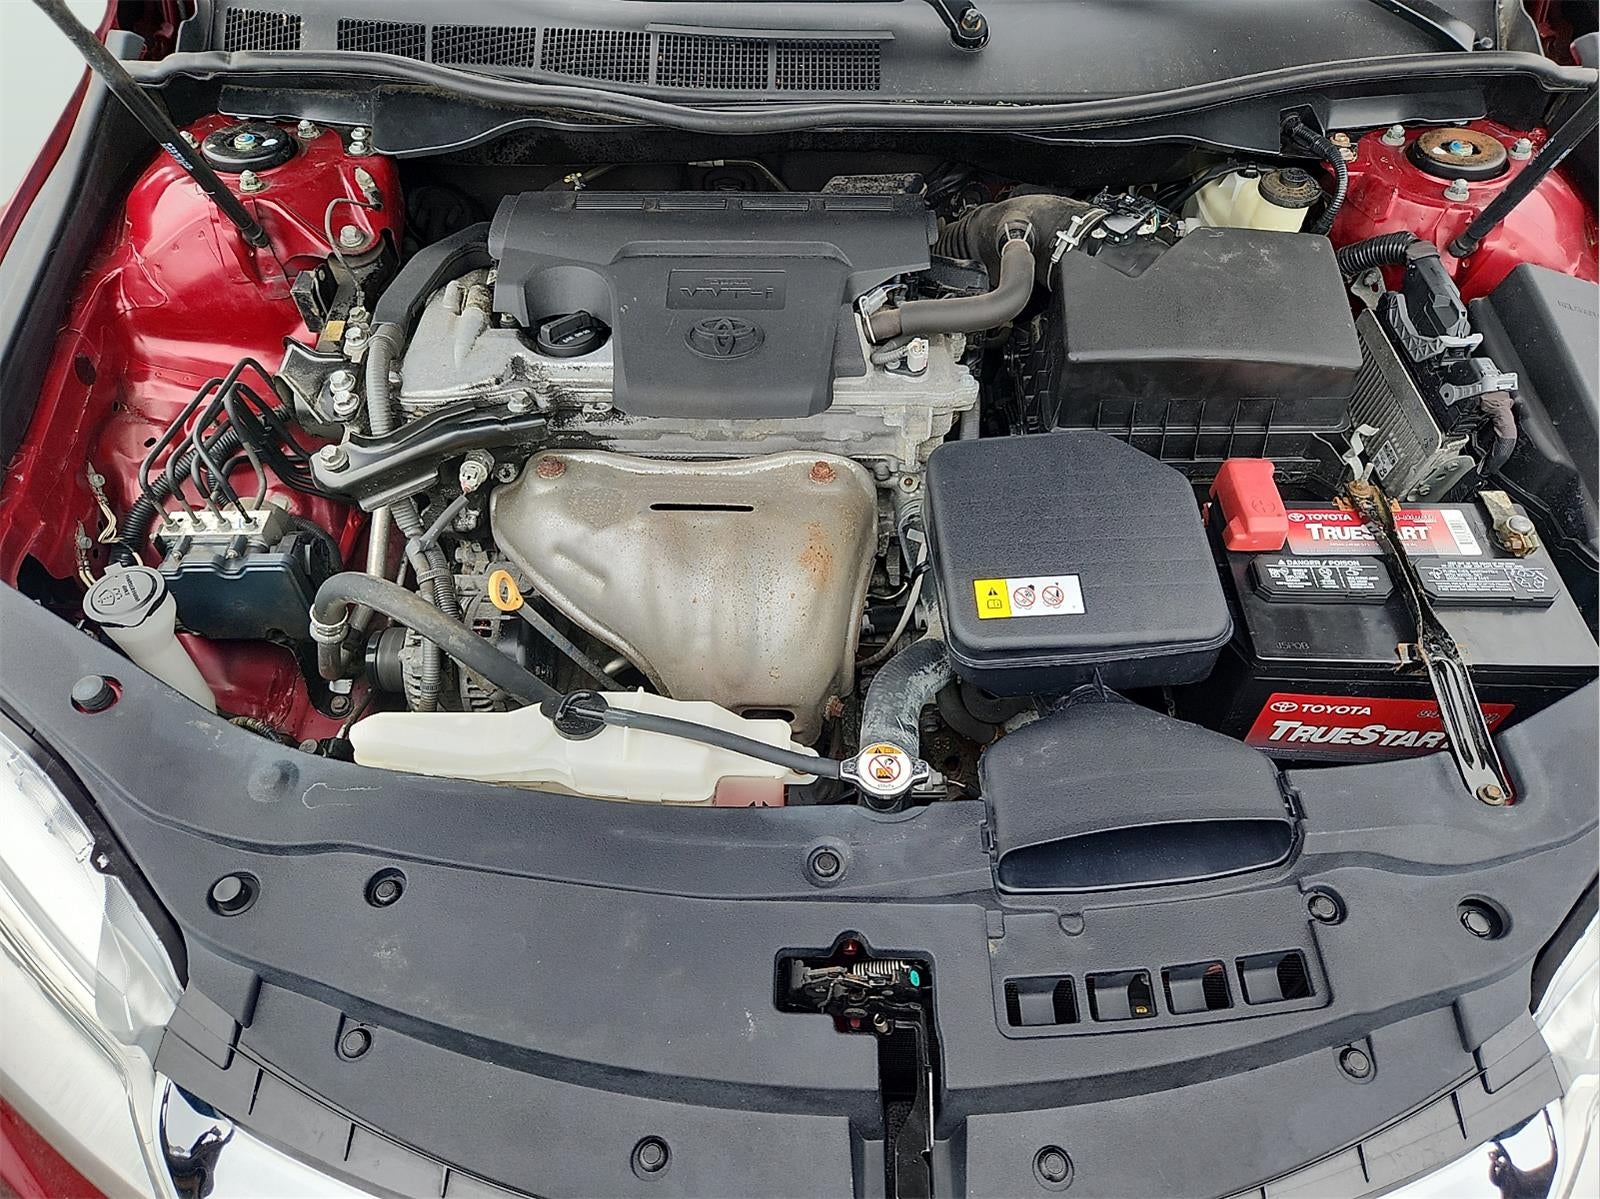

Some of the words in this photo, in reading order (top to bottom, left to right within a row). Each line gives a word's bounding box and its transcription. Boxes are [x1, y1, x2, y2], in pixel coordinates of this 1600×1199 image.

[1305, 513, 1353, 521] TOYOTA
[1301, 703, 1372, 716] TOYOTA
[1268, 720, 1449, 749] TRUESTAR
